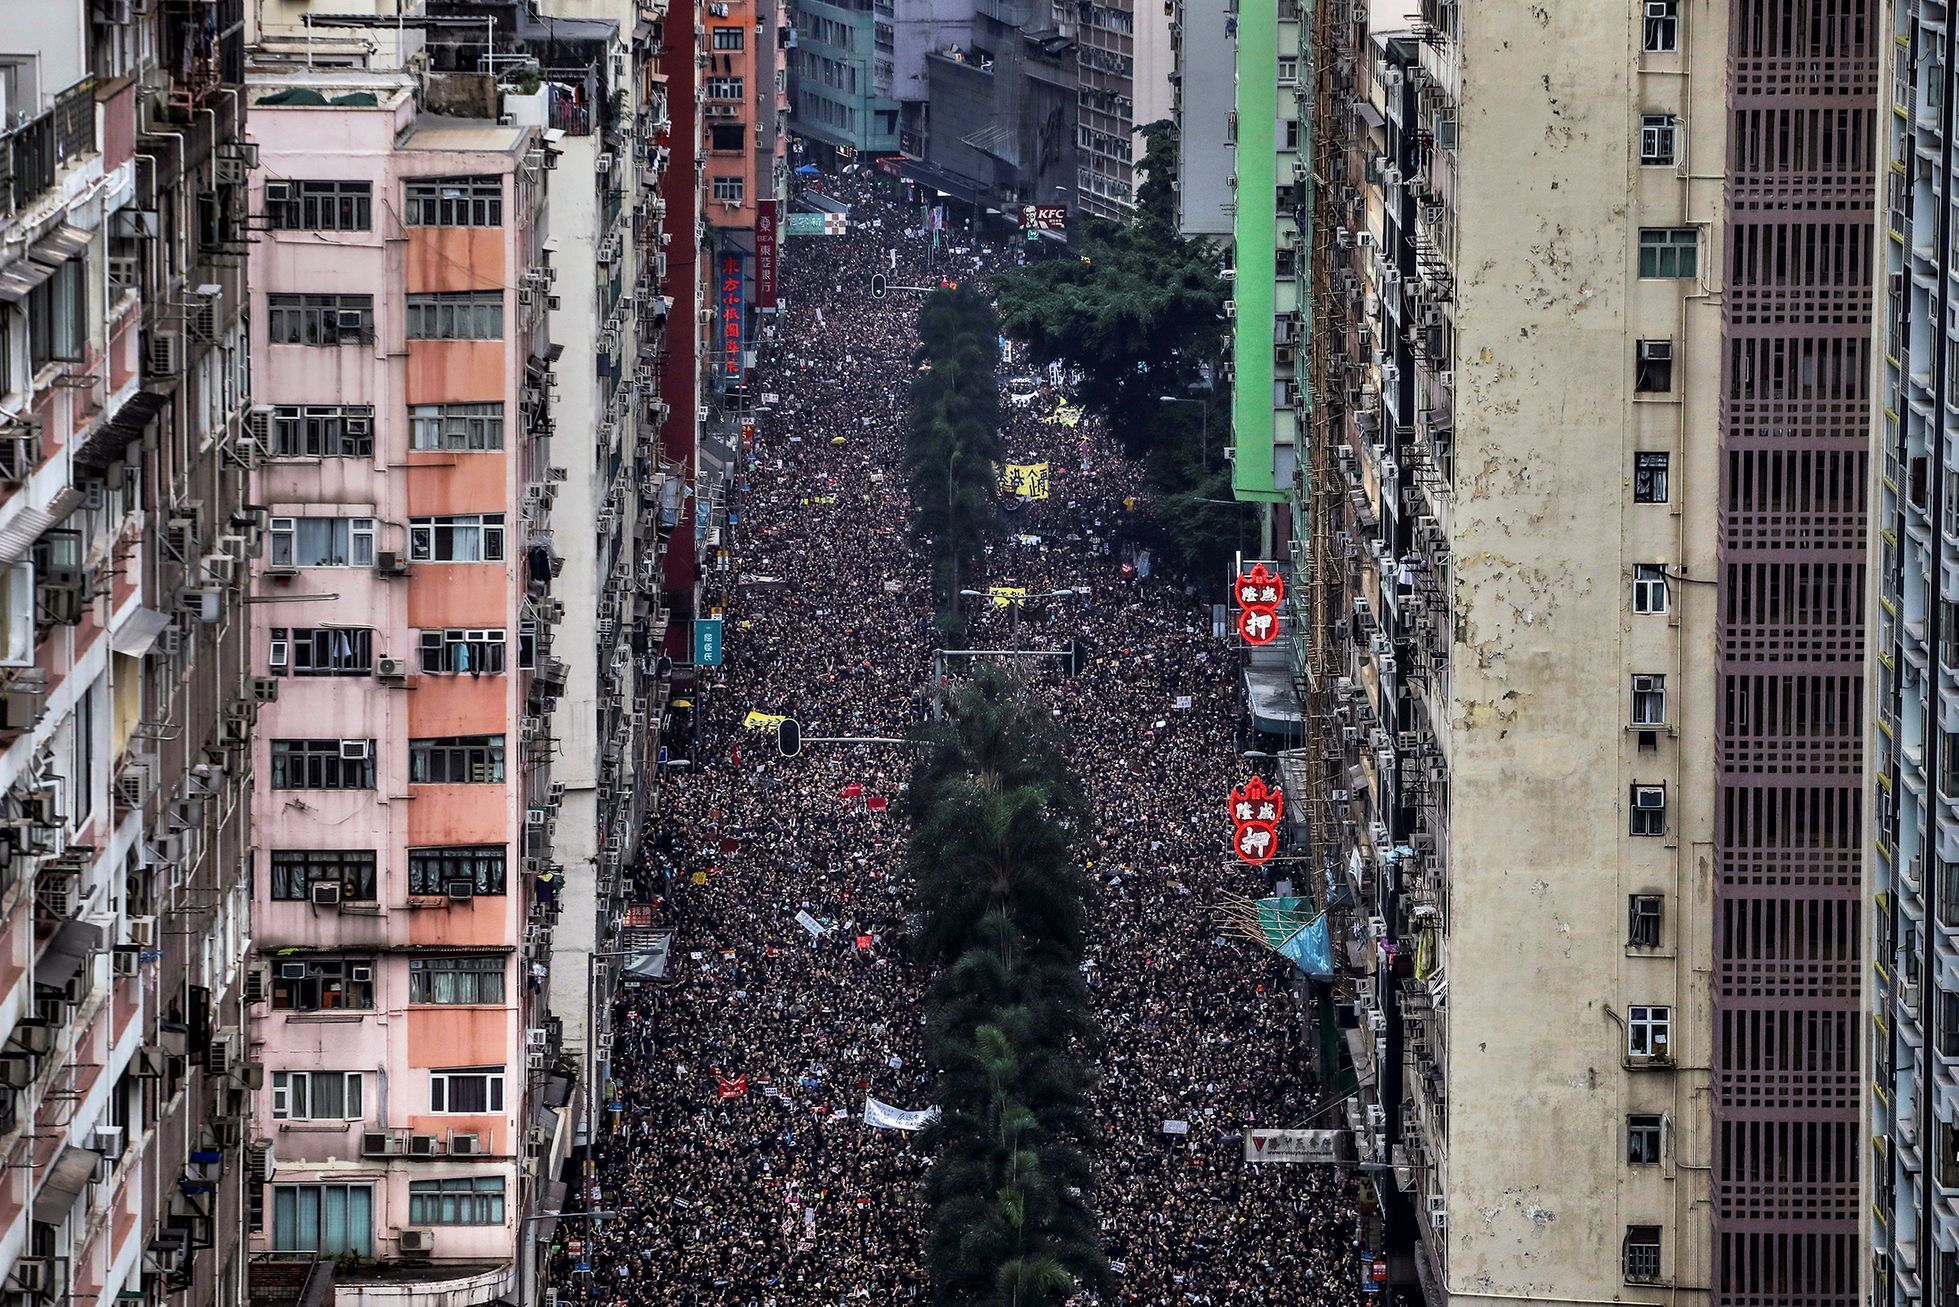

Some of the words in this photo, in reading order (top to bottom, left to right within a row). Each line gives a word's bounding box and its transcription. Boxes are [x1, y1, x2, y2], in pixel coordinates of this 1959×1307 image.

[1038, 209, 1065, 219] KFC
[760, 245, 771, 293] 東亞銀行
[1245, 611, 1273, 640] 押
[1240, 826, 1271, 857] 押
